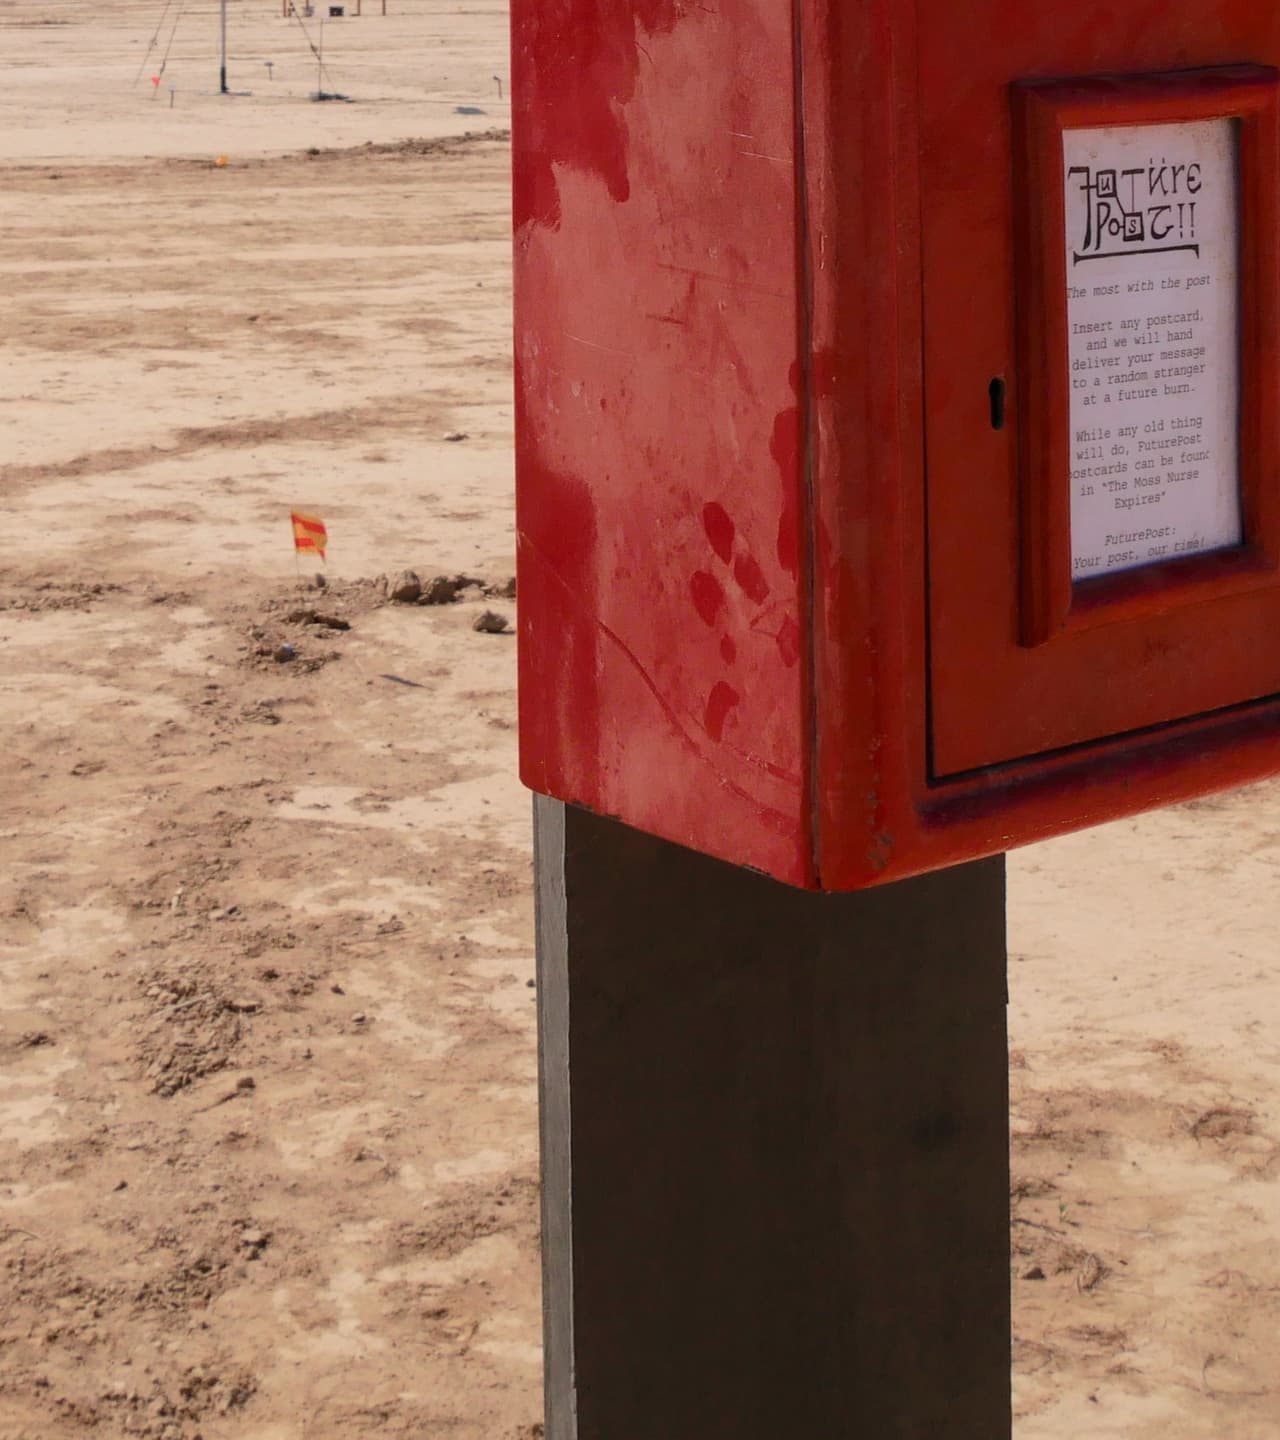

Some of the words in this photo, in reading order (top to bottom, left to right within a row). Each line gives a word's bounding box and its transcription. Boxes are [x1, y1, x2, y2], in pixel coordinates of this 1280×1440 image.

[1093, 284, 1120, 296] most
[1127, 280, 1154, 293] with
[1161, 277, 1180, 289] the
[1186, 275, 1211, 290] post
[1073, 321, 1112, 334] Insert
[1120, 317, 1141, 331] any
[1086, 338, 1107, 351] and
[1114, 338, 1127, 347] we
[1134, 332, 1160, 345] will
[1167, 329, 1193, 342] hand
[1072, 355, 1120, 371] deliver
[1128, 351, 1154, 367] your
[1160, 346, 1205, 361] message
[1072, 377, 1087, 389] to
[1094, 377, 1100, 386] a
[1108, 371, 1148, 385] random
[1154, 363, 1206, 379] stranger
[1083, 393, 1096, 406] at
[1104, 394, 1111, 403] a
[1118, 385, 1158, 401] future
[1164, 382, 1196, 395] burn.
[1076, 427, 1111, 443] While
[1118, 425, 1138, 438] any
[1144, 421, 1164, 433] old
[1171, 417, 1202, 430] thing
[1077, 446, 1104, 460] will
[1111, 444, 1129, 456] do,
[1138, 433, 1202, 452] FuturePost
[1135, 458, 1154, 470] can
[1161, 455, 1173, 467] be
[1080, 485, 1094, 496] in
[1134, 475, 1160, 488] Moss
[1168, 469, 1198, 483] Nurse
[1105, 526, 1176, 546] FuturePost:
[1074, 555, 1101, 569] Your
[1107, 552, 1139, 567] post,
[1147, 545, 1168, 556] our
